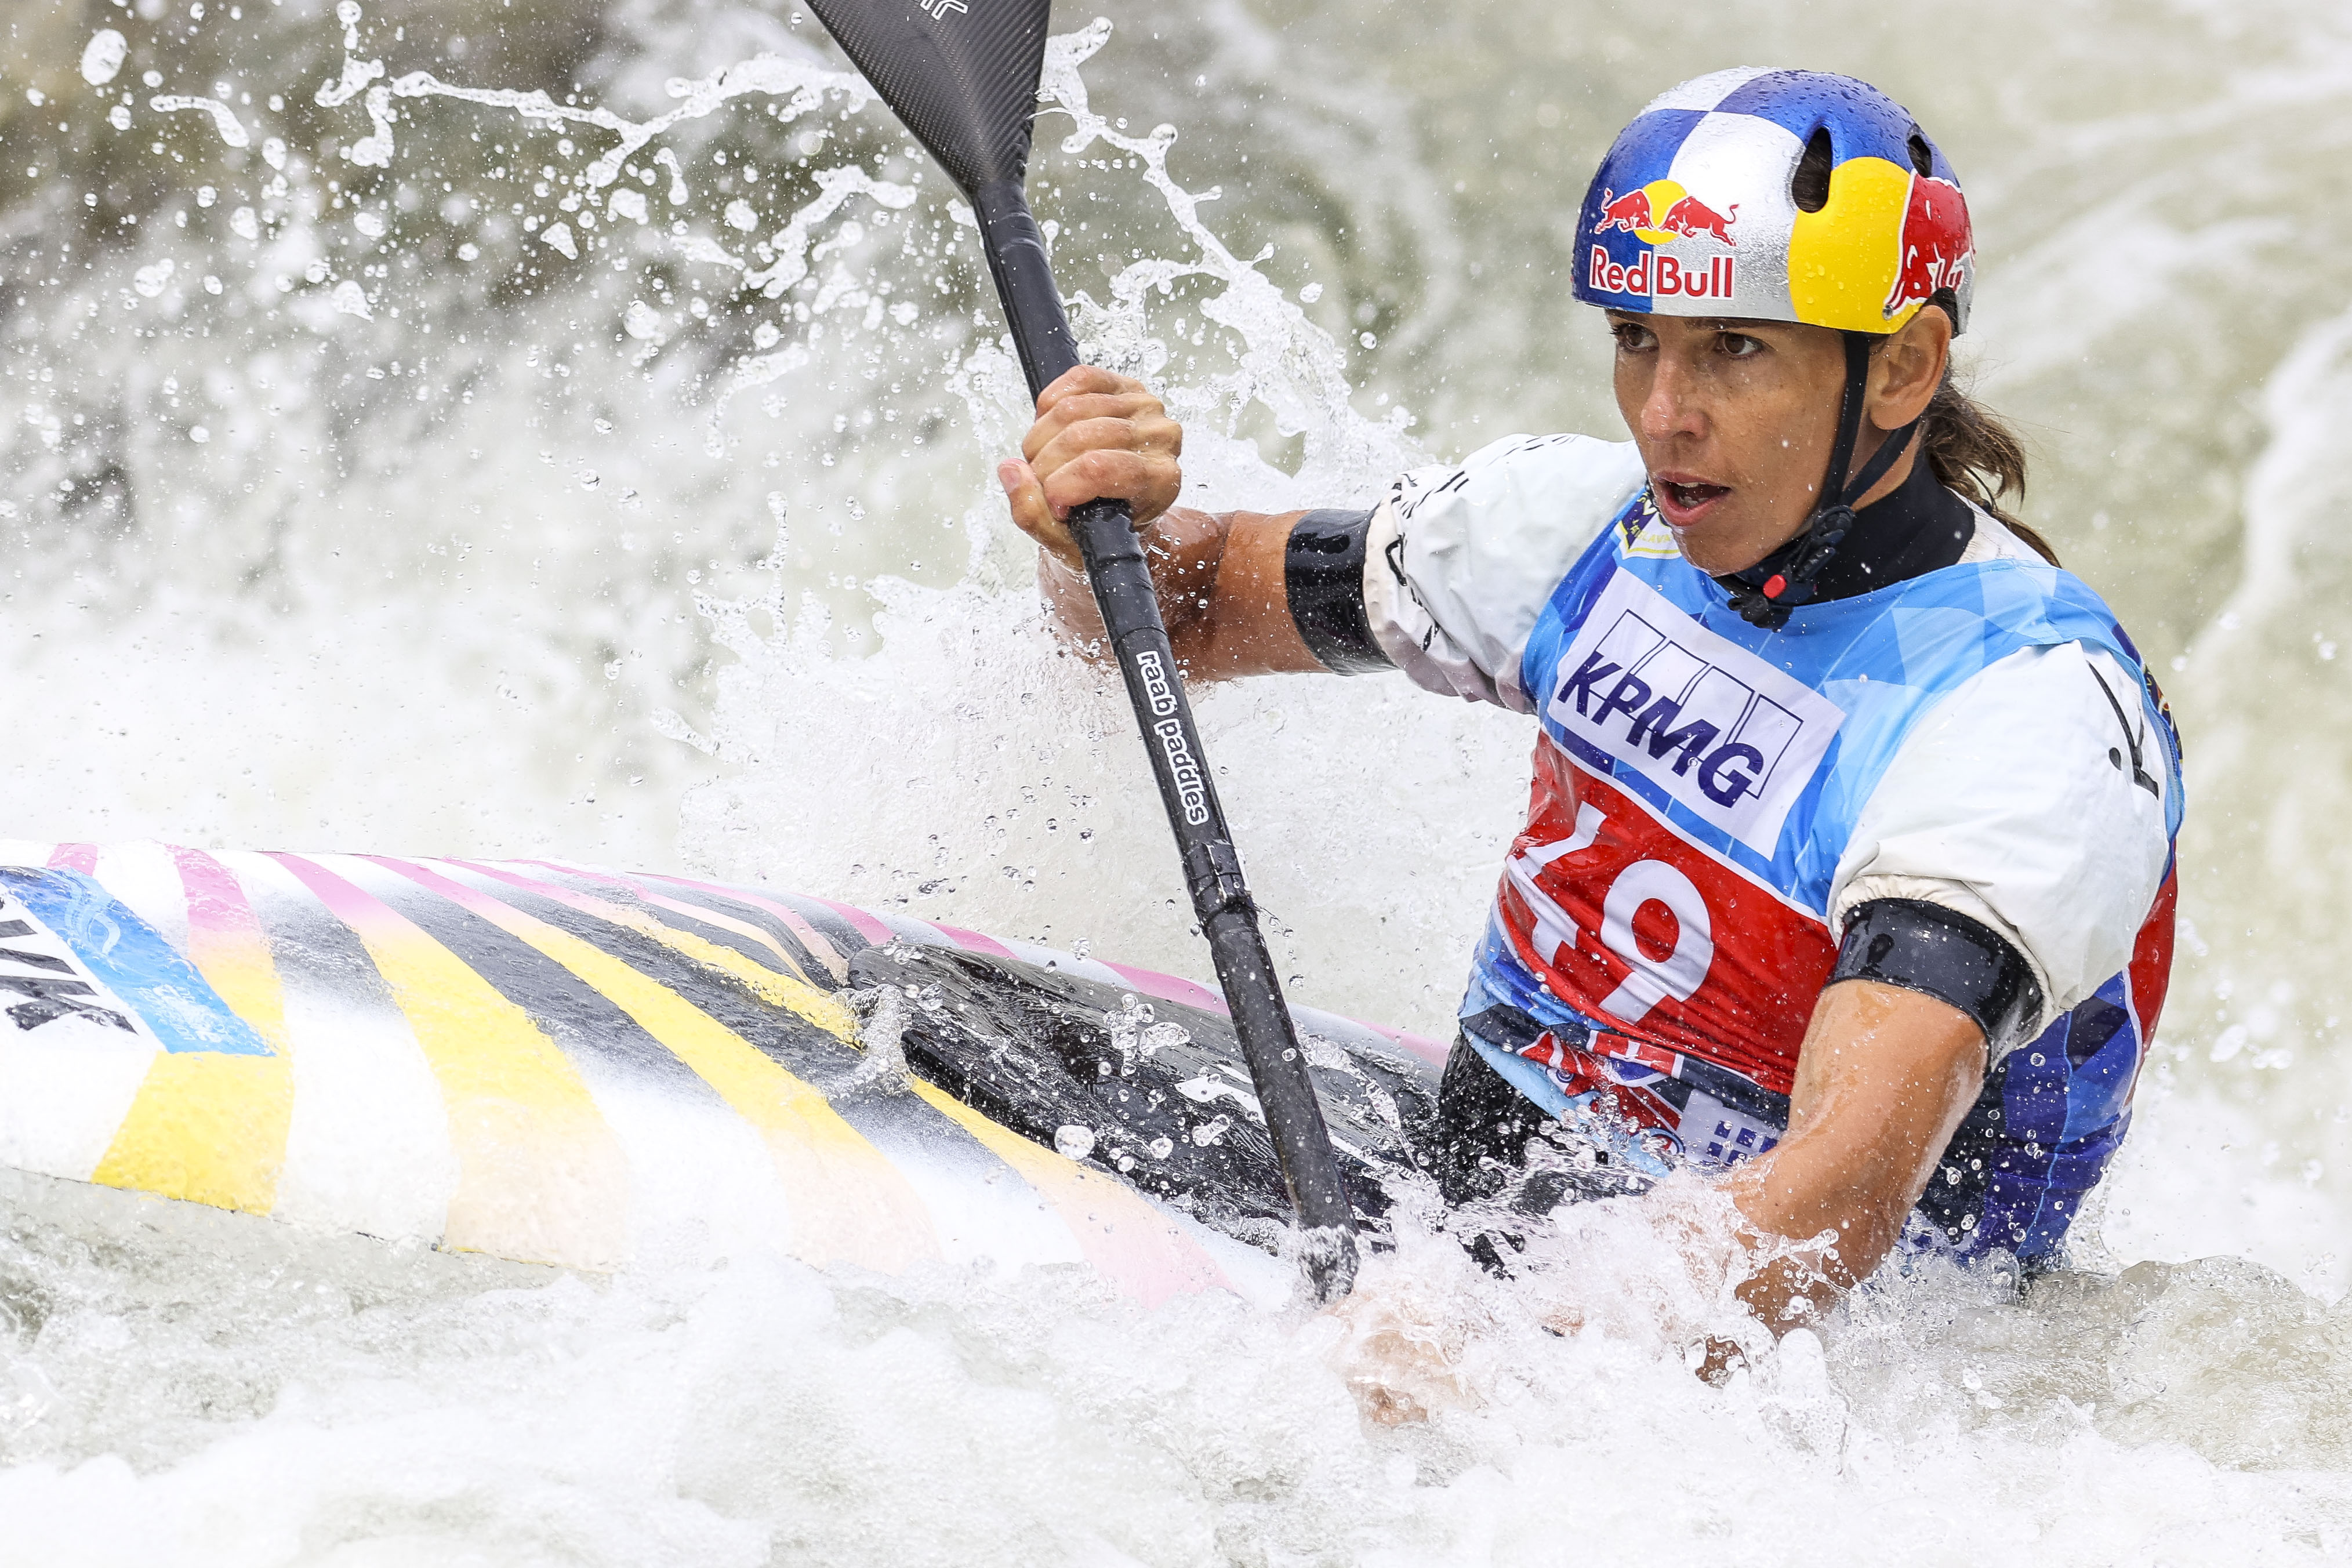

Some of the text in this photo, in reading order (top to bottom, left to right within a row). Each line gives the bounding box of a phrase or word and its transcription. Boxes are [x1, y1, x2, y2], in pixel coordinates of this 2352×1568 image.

[1589, 245, 1735, 300] Red Bull
[1136, 651, 1209, 826] raab paddles
[1558, 651, 1764, 809] KPMG
